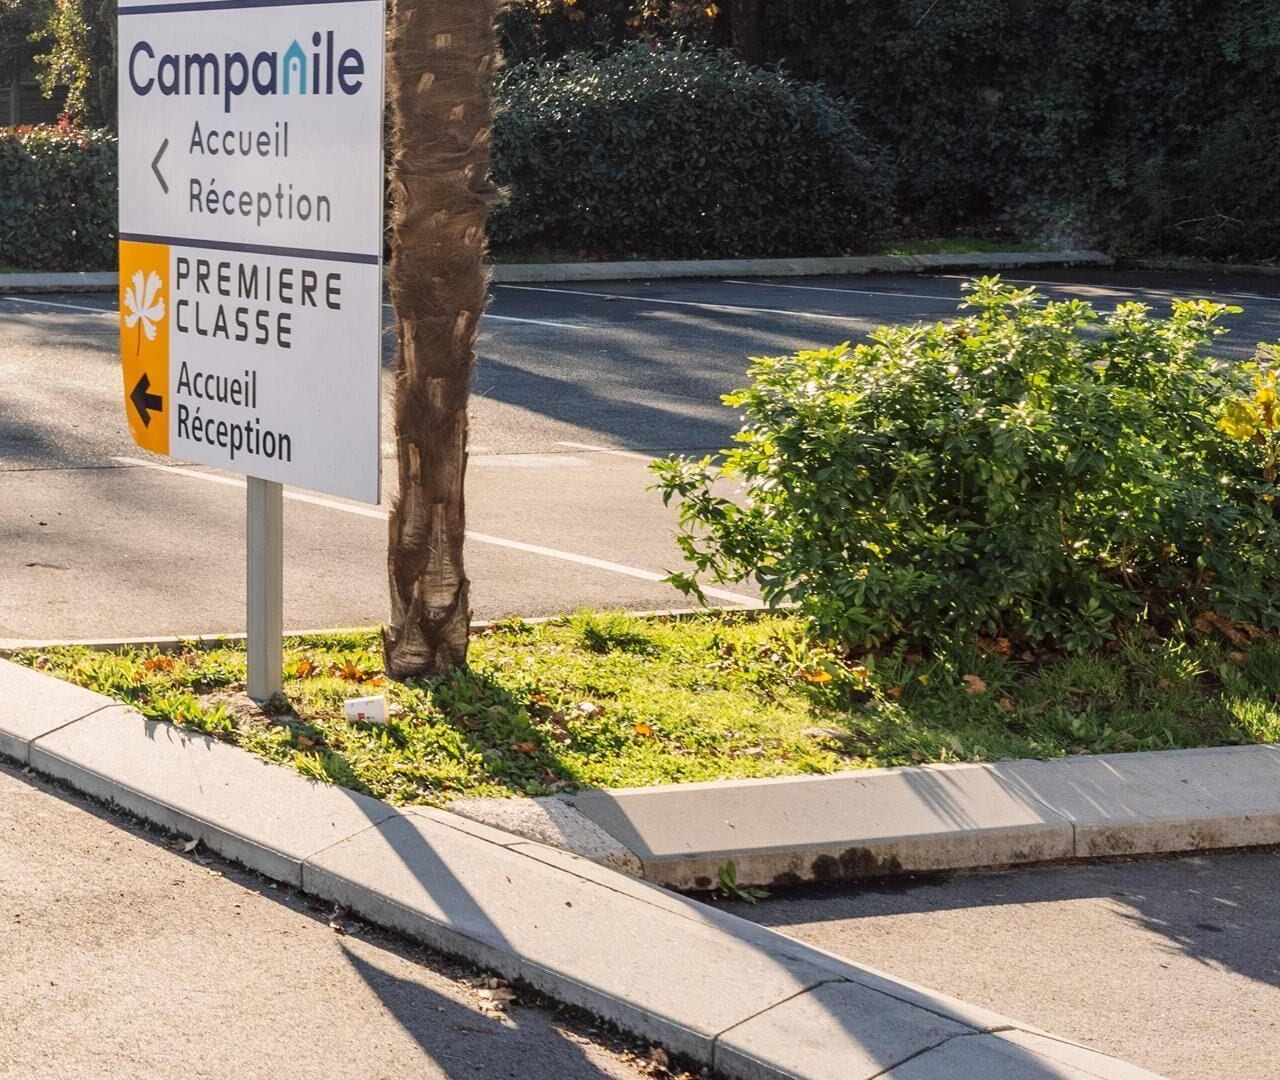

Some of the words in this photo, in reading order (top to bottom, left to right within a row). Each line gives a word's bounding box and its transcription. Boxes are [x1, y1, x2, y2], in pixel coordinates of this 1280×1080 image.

[129, 30, 365, 113] Campanile
[189, 120, 288, 157] Accueil
[189, 178, 331, 226] Réception
[176, 257, 341, 310] PREMIERE
[176, 299, 291, 348] CLASSE
[177, 361, 257, 409] Accueil
[177, 404, 291, 462] Réception
